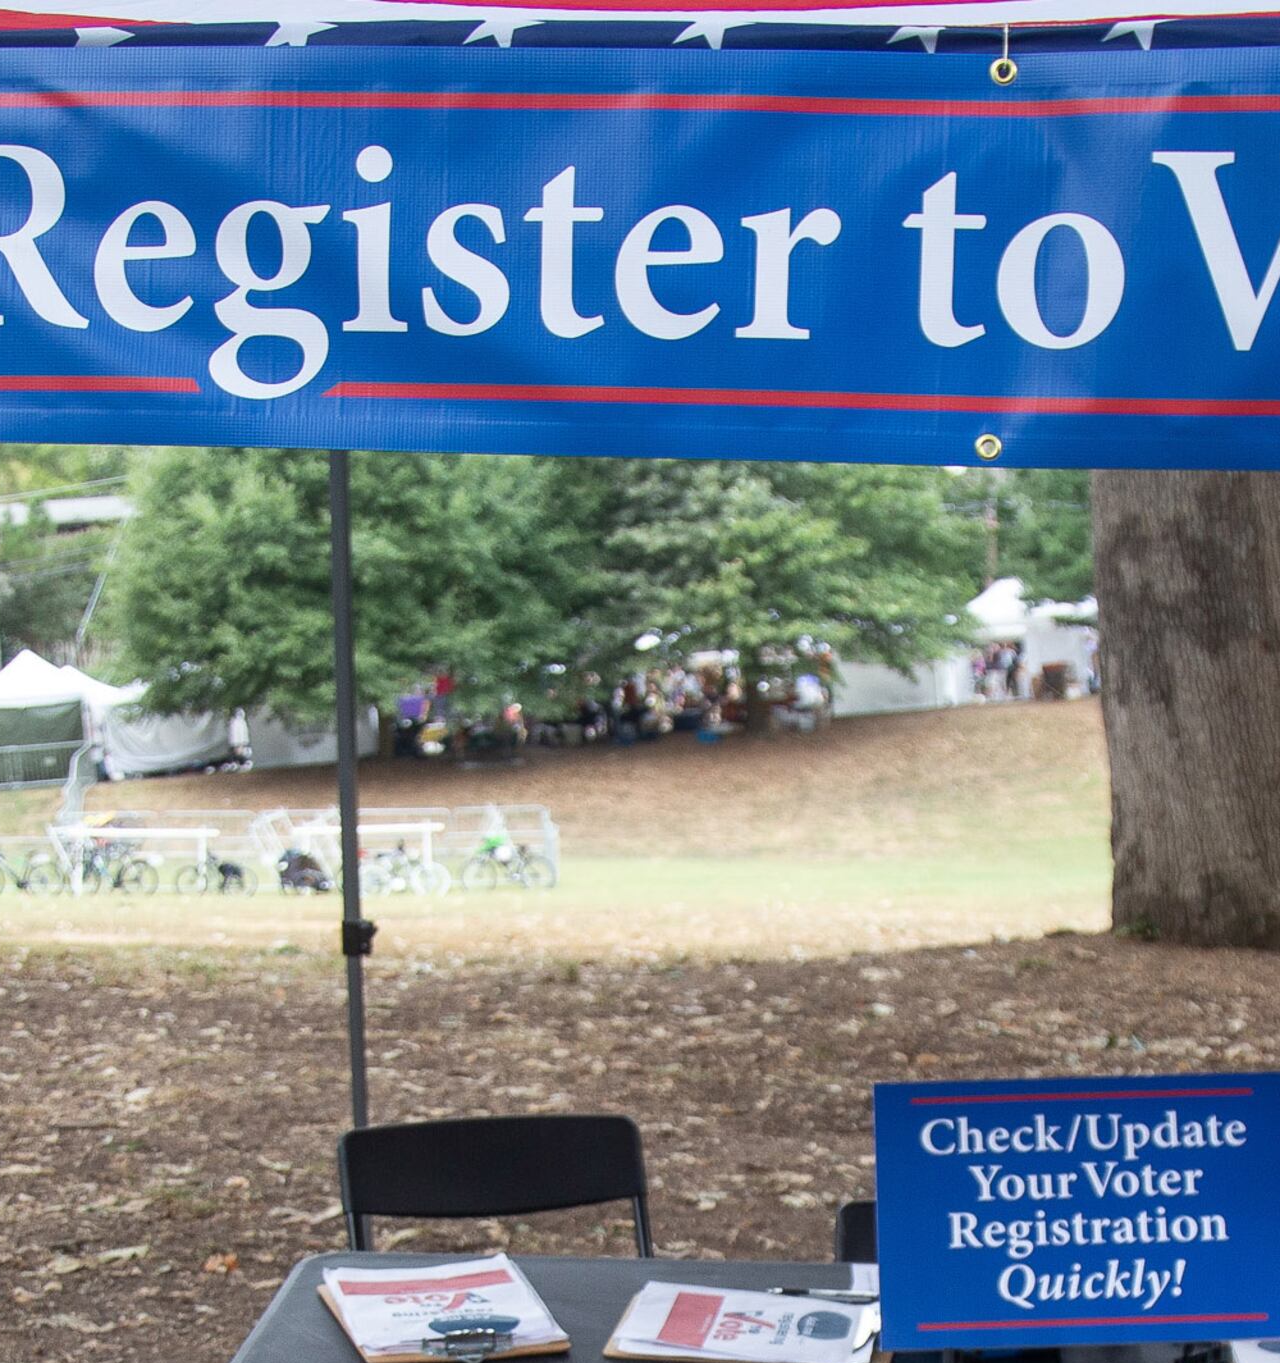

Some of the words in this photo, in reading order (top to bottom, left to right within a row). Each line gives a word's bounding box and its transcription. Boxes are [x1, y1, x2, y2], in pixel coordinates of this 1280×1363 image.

[903, 172, 1124, 349] to
[921, 1111, 1246, 1160] Check/Update
[969, 1165, 1077, 1200] Your
[1082, 1162, 1203, 1197] Voter
[949, 1207, 1229, 1259] Registration
[998, 1259, 1186, 1309] Quickly!
